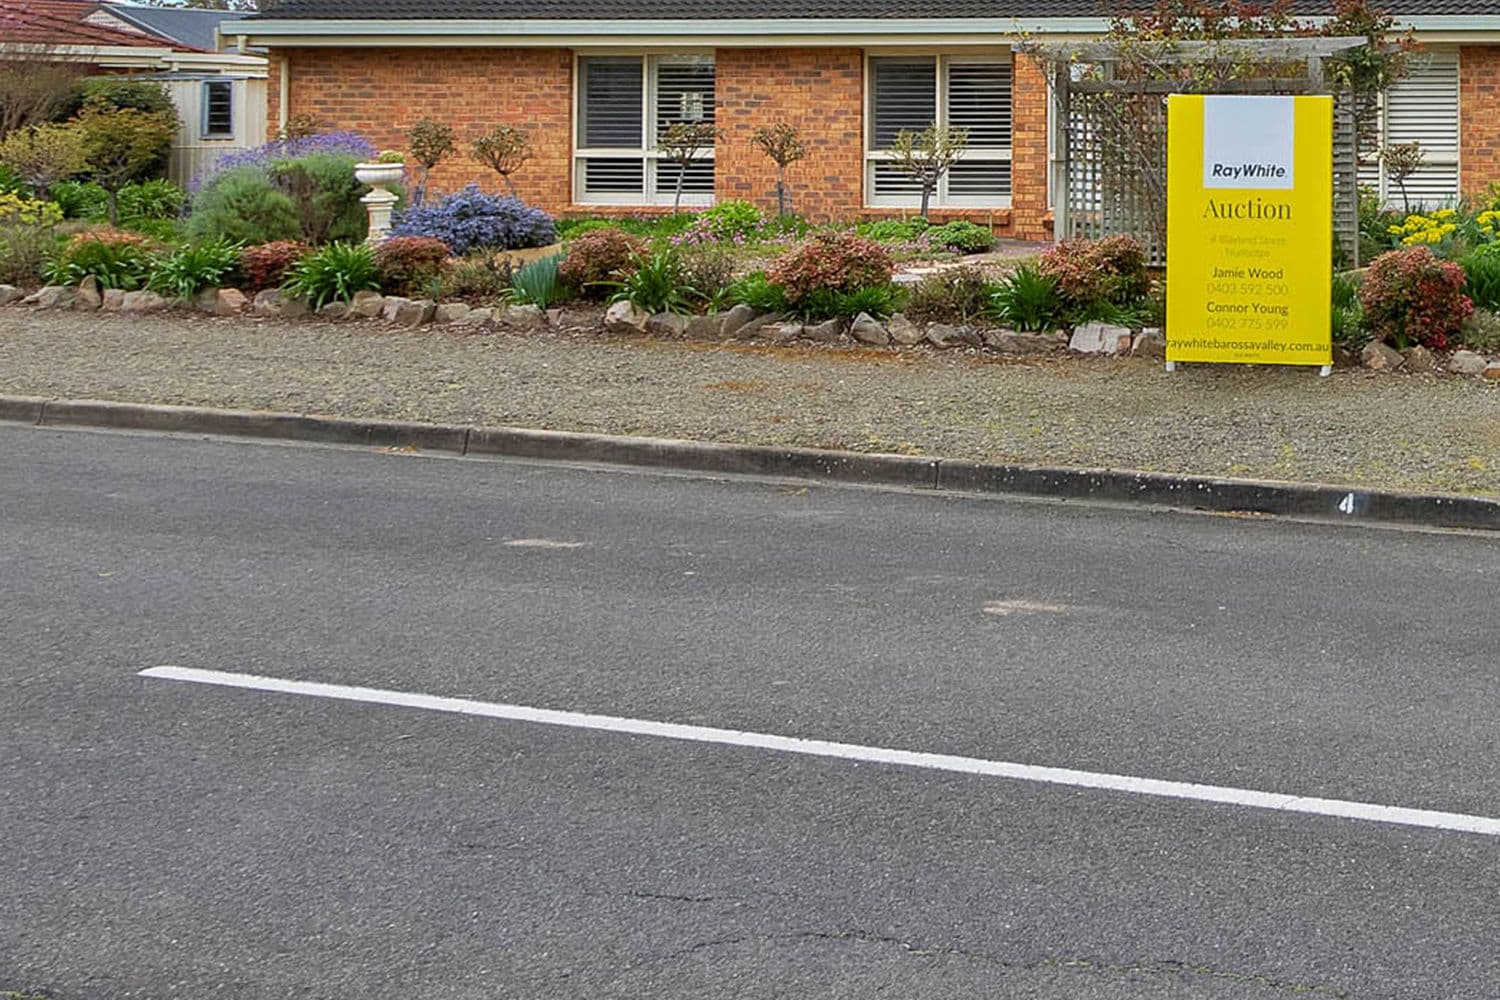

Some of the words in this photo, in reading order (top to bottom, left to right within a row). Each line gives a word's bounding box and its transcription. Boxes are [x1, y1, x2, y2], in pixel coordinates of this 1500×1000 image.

[1203, 197, 1292, 220] Auction
[1212, 267, 1245, 279] Jamie
[1248, 268, 1284, 280] Wood
[1267, 285, 1289, 297] 500
[1206, 301, 1249, 314] Connor
[1252, 303, 1289, 316] Young
[1167, 337, 1329, 353] raywhitebarossavalley.com.au
[1339, 492, 1354, 514] 4
